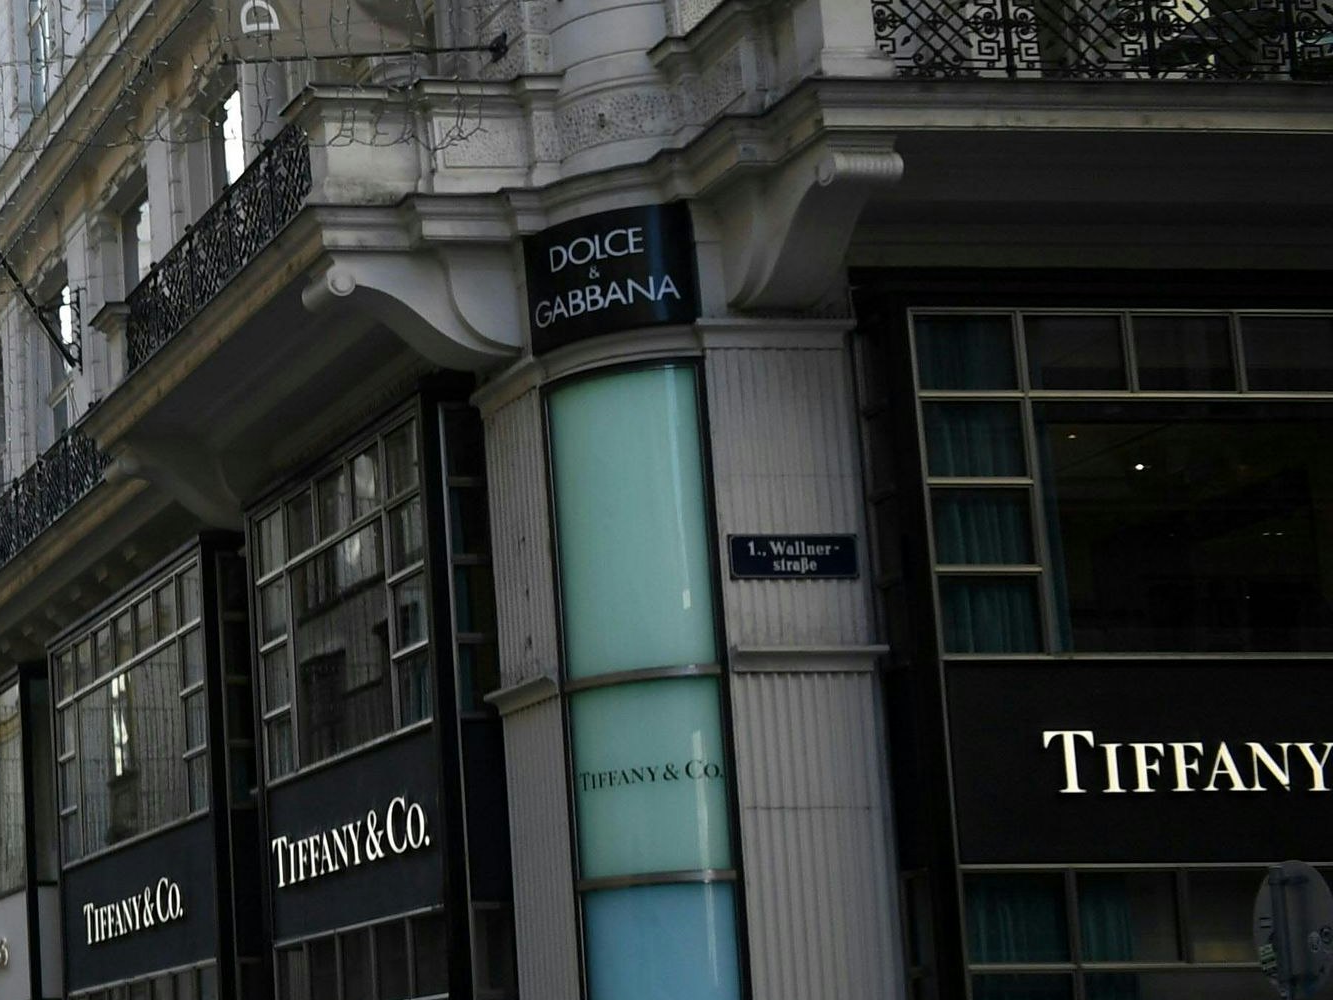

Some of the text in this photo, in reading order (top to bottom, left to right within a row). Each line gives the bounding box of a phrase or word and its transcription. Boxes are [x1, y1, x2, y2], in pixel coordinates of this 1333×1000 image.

[549, 227, 644, 273] DOLCE
[589, 265, 600, 279] &
[535, 274, 681, 328] GABBANA
[747, 540, 840, 557] 1., Wallner-
[773, 557, 818, 574] straße
[580, 767, 659, 791] TIFFANY
[663, 762, 679, 781] &
[1042, 730, 1333, 793] TIFFANY
[272, 820, 362, 888] TIFFANY
[365, 809, 385, 861] &
[83, 894, 142, 945] TIFFANY
[143, 886, 155, 928] &
